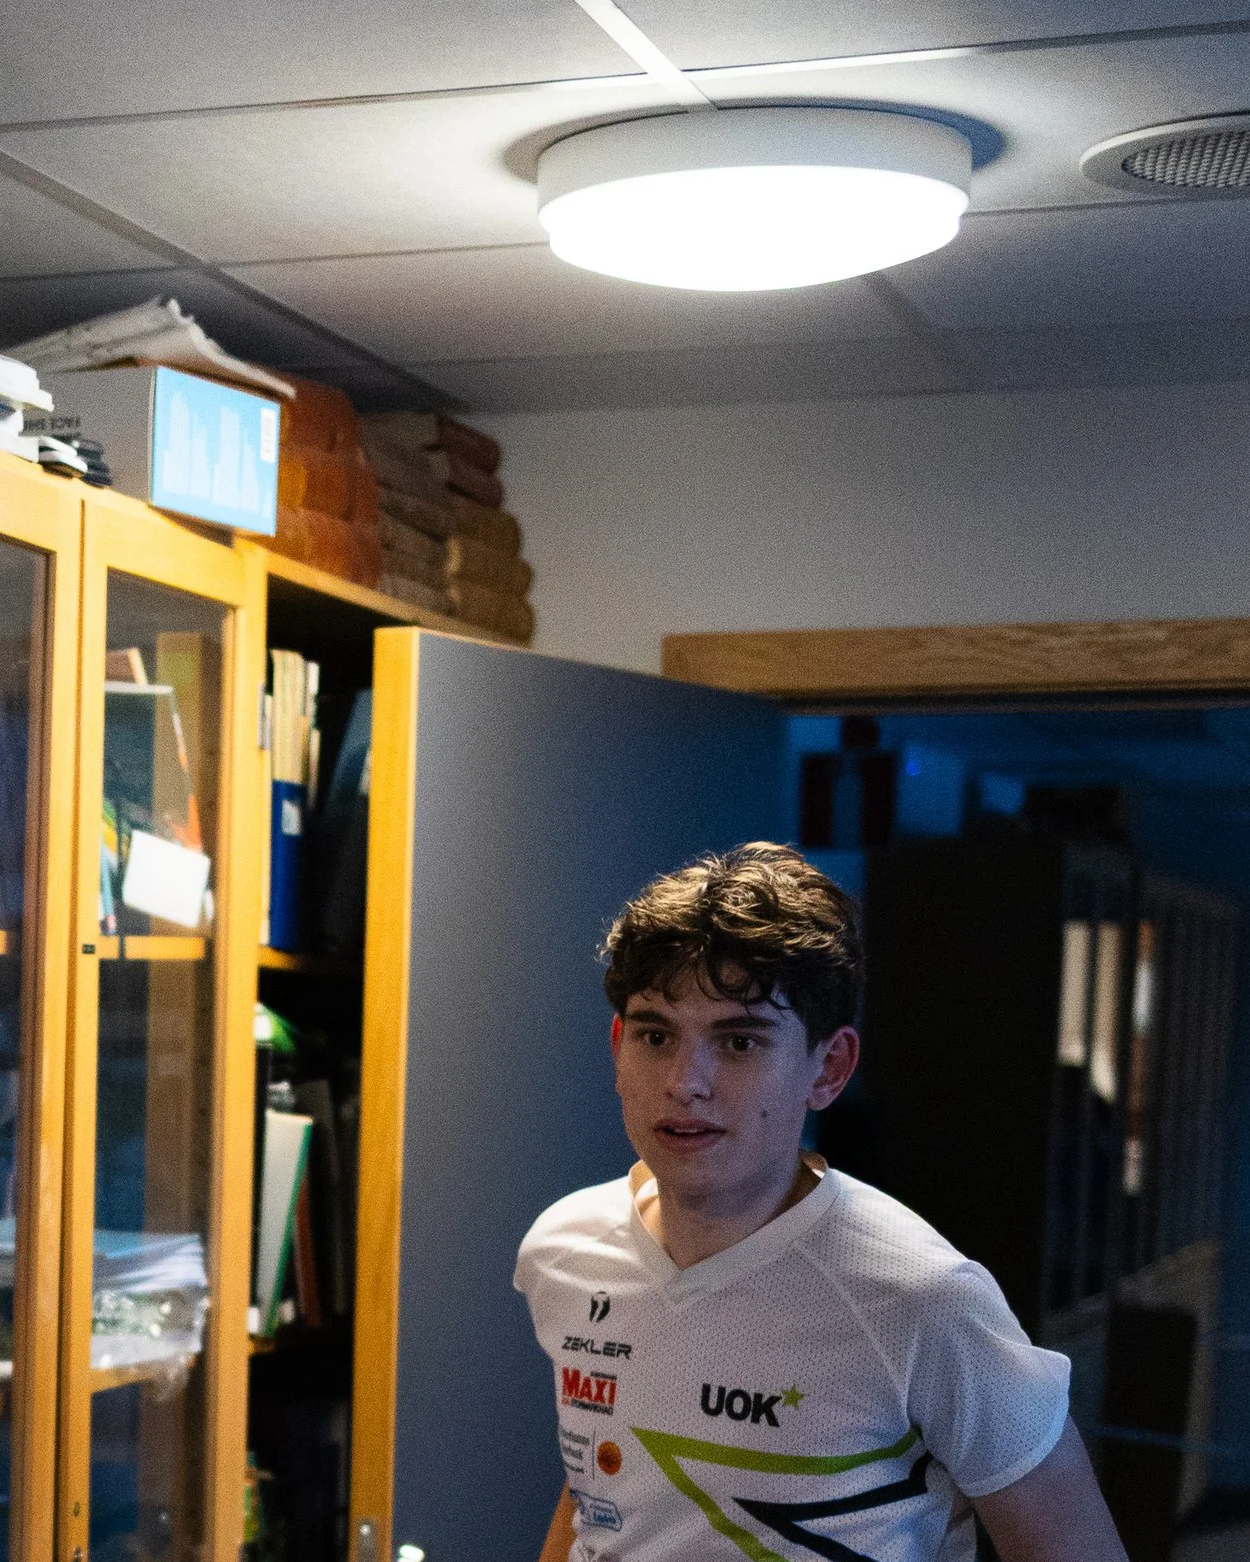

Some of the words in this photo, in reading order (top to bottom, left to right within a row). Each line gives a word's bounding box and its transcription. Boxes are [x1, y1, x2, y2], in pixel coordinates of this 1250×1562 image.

[562, 1336, 633, 1360] ZEKLER
[562, 1367, 616, 1406] MAXI
[701, 1383, 782, 1427] UOK
